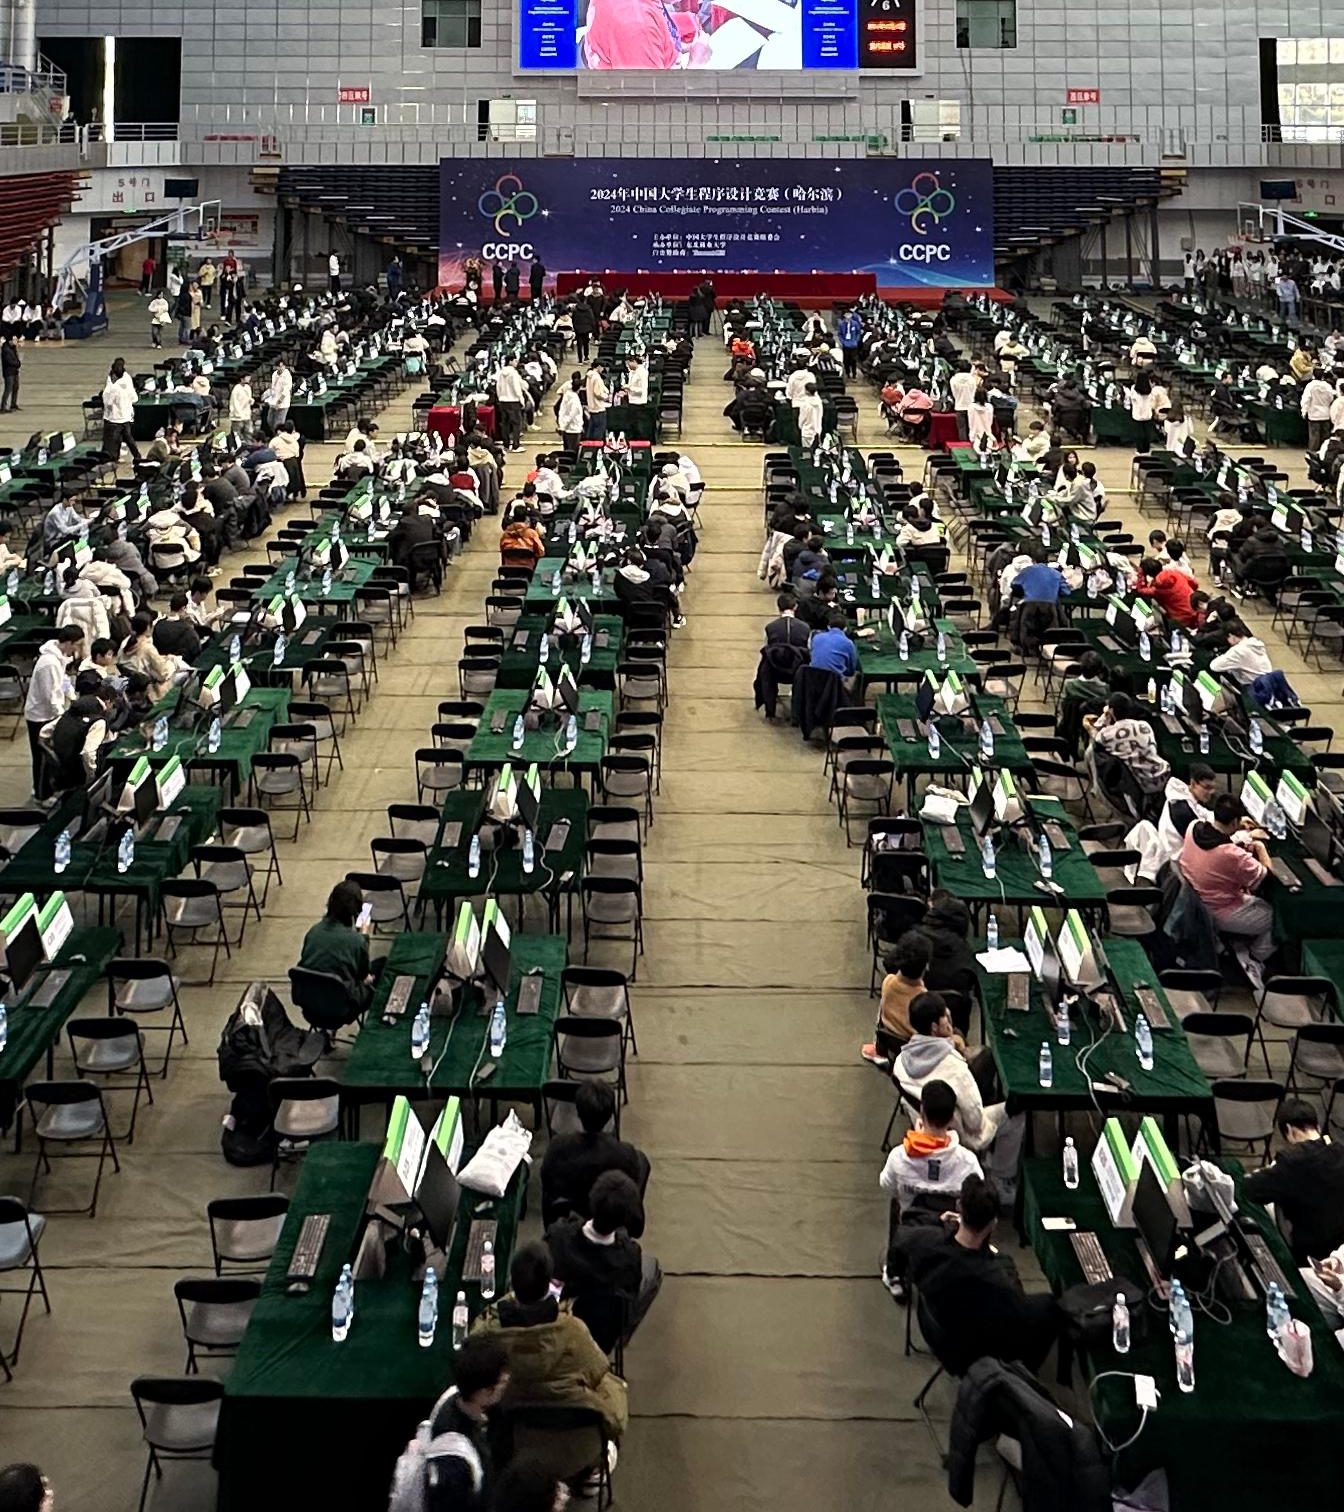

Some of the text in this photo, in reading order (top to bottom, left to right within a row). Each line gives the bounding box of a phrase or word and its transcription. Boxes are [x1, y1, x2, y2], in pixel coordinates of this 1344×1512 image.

[882, 0, 891, 10] 6
[112, 191, 155, 203] 出口
[610, 205, 829, 216] 2024 China Collegiate Programming Contest (Harbin)
[482, 242, 534, 261] CCPC
[899, 244, 951, 263] CCPC
